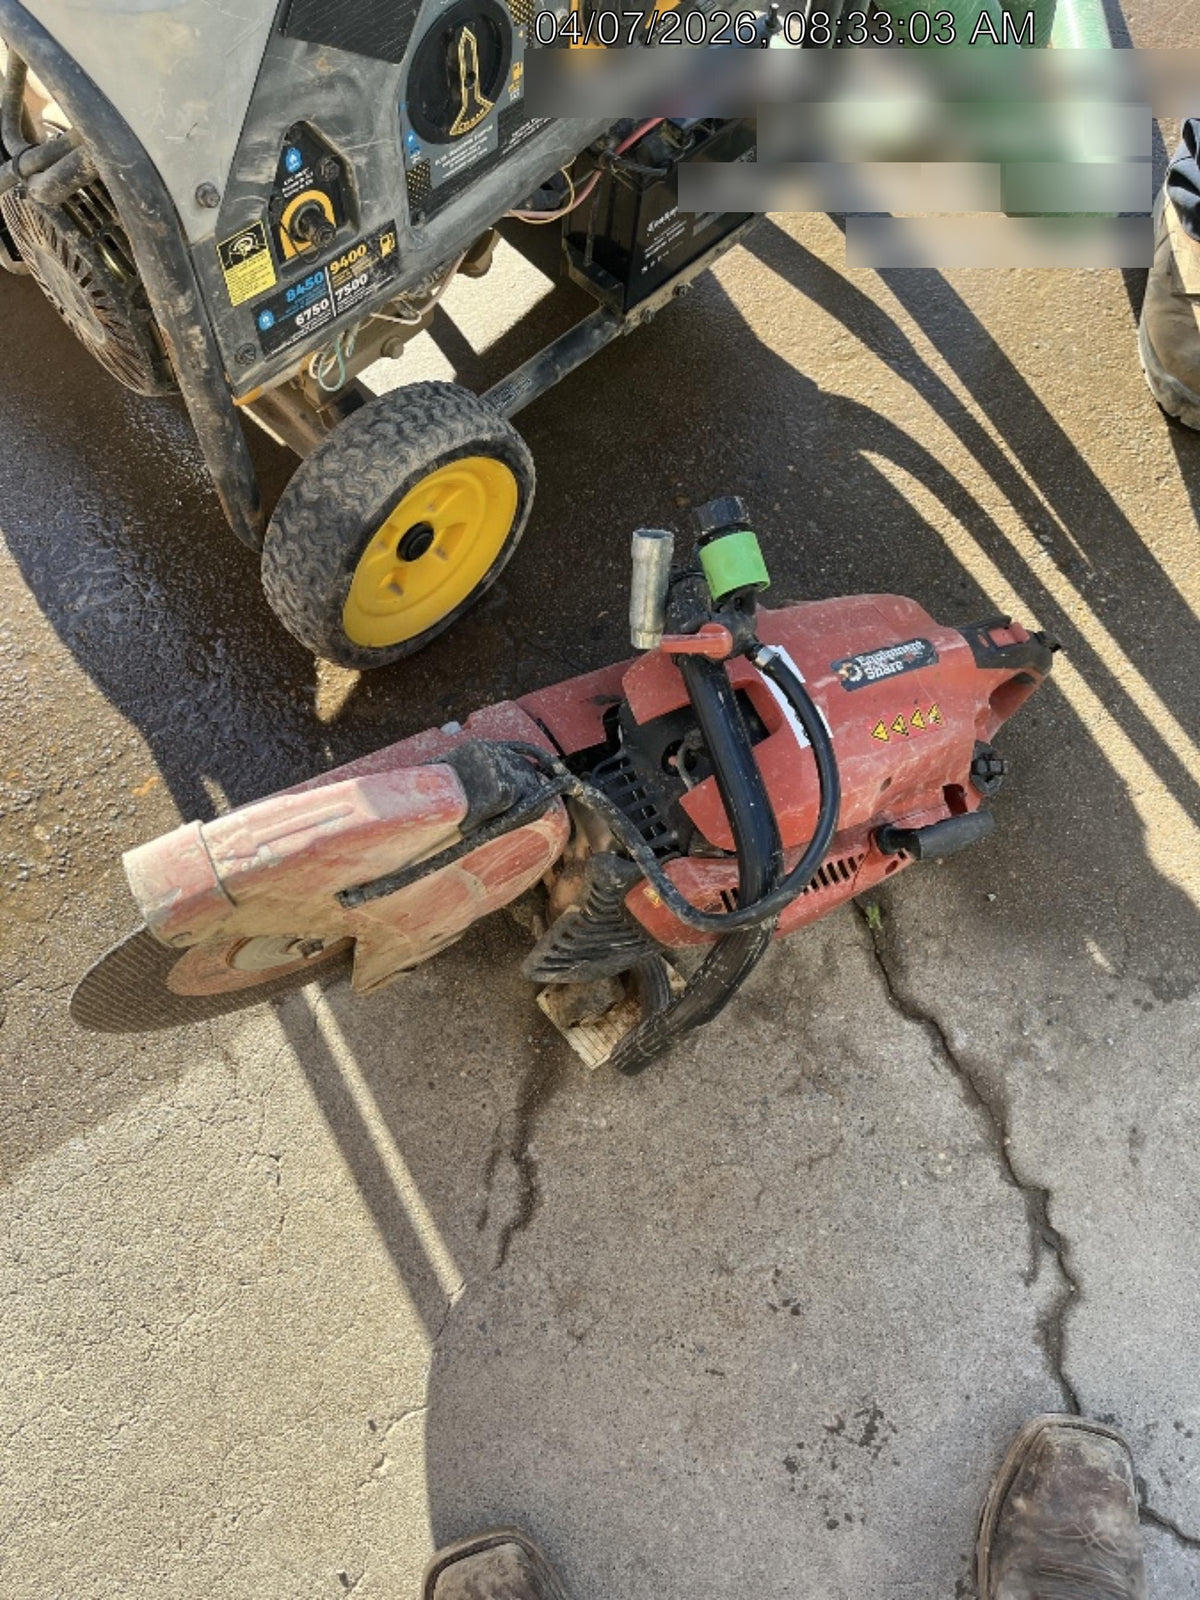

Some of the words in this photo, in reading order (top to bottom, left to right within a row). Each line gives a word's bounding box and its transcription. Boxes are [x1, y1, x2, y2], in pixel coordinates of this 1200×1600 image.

[329, 244, 367, 275] 9400
[285, 271, 324, 303] 8450
[335, 273, 368, 301] 7500
[295, 298, 330, 326] 6750
[863, 659, 905, 680] Share
